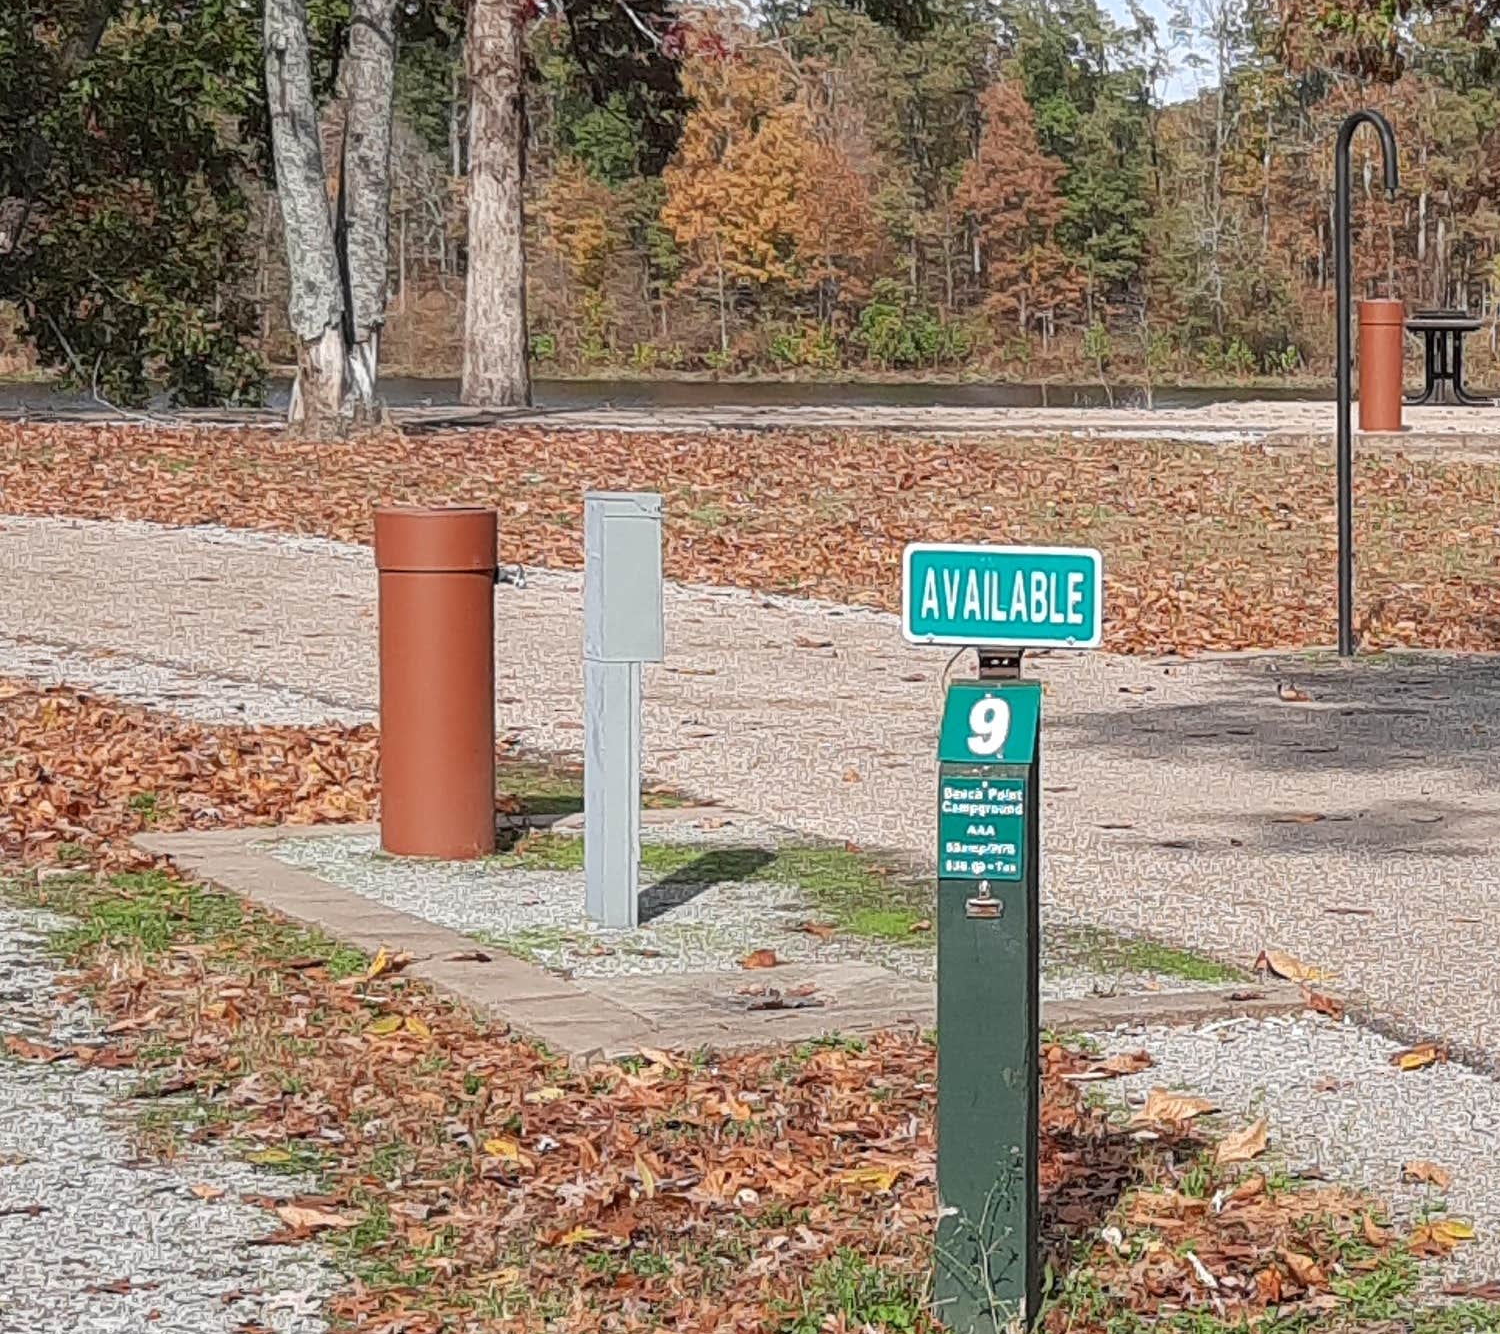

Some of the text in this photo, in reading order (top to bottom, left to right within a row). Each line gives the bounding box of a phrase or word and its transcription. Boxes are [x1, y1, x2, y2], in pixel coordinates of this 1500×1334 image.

[921, 566, 1084, 624] AVAILABLE
[967, 698, 1010, 755] 9
[942, 800, 1024, 817] Campground
